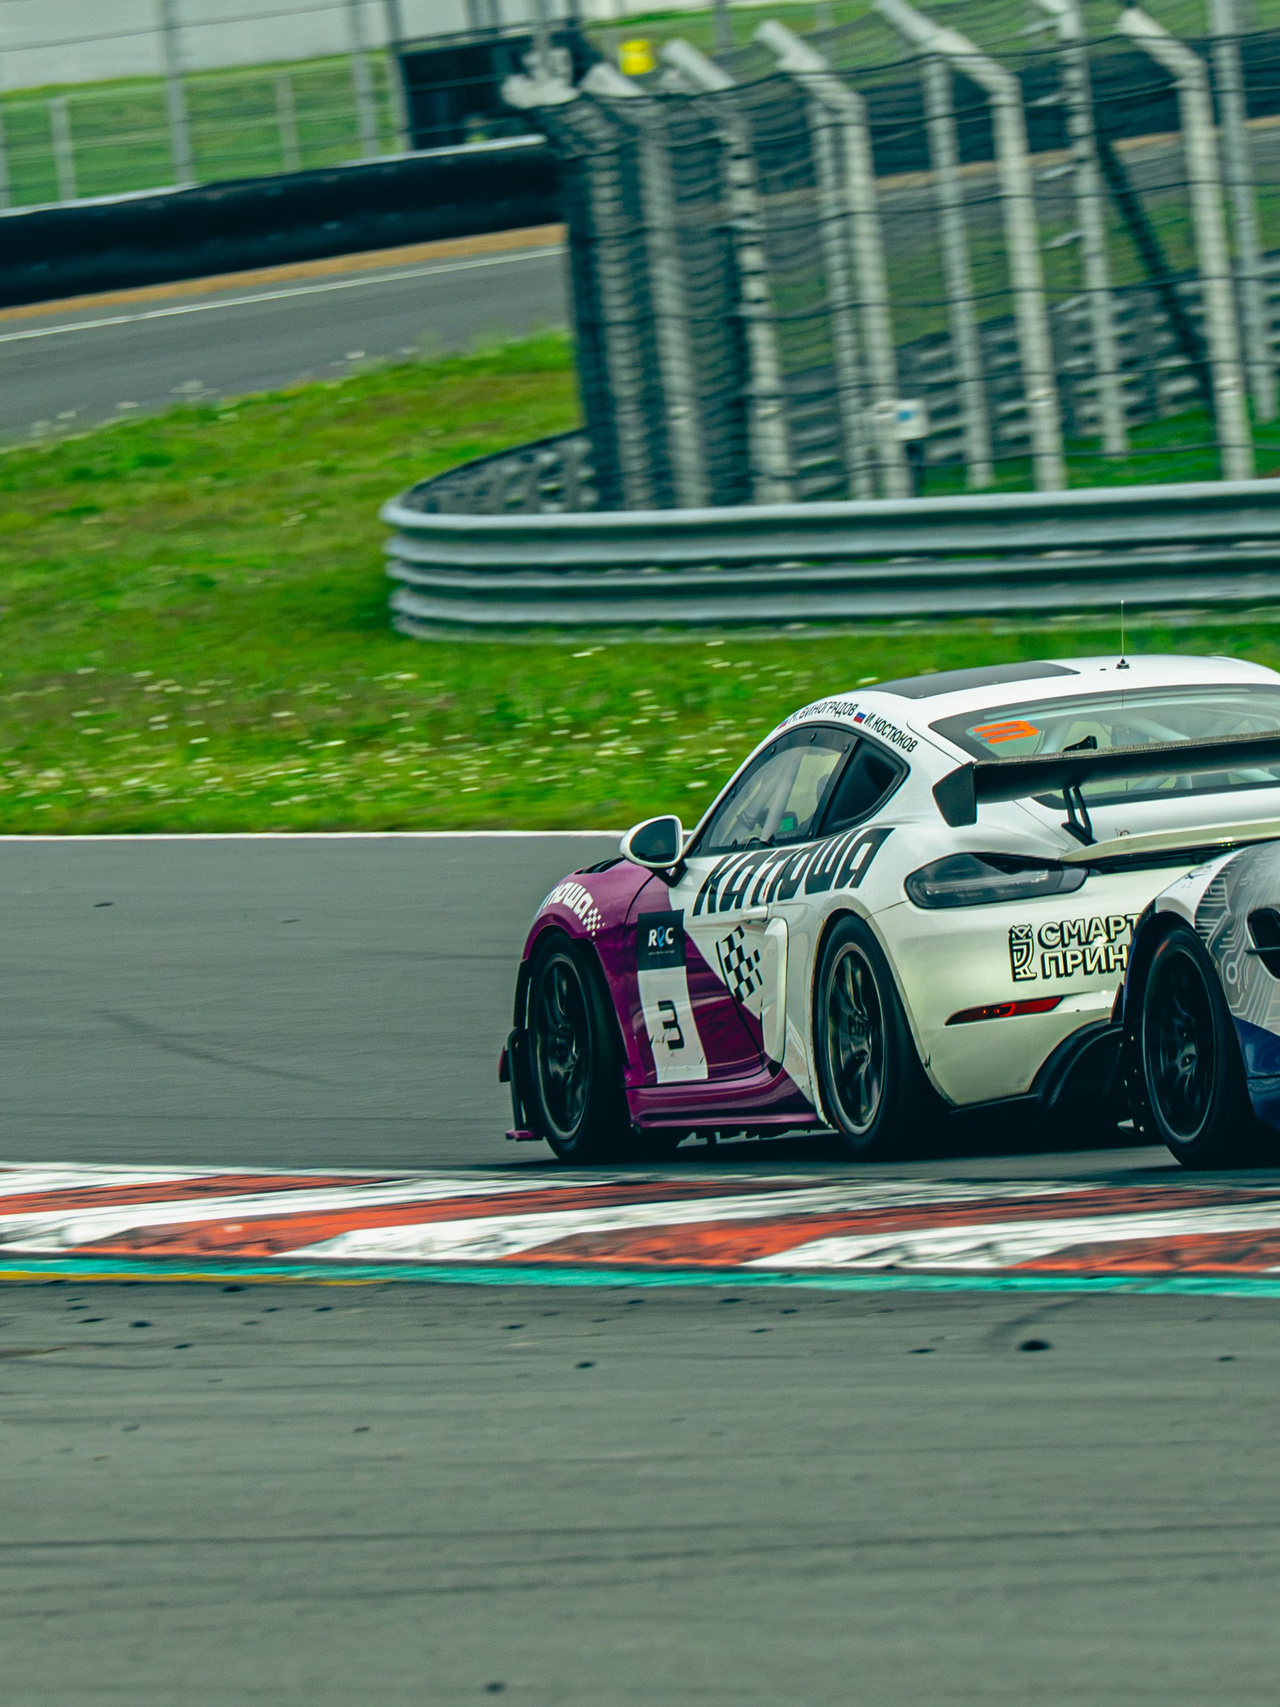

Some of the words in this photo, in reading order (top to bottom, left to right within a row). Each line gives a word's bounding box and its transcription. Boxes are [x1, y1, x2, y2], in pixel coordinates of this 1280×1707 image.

[973, 720, 1038, 744] 3
[1041, 944, 1128, 979] ПРИН
[657, 1000, 685, 1050] 3
